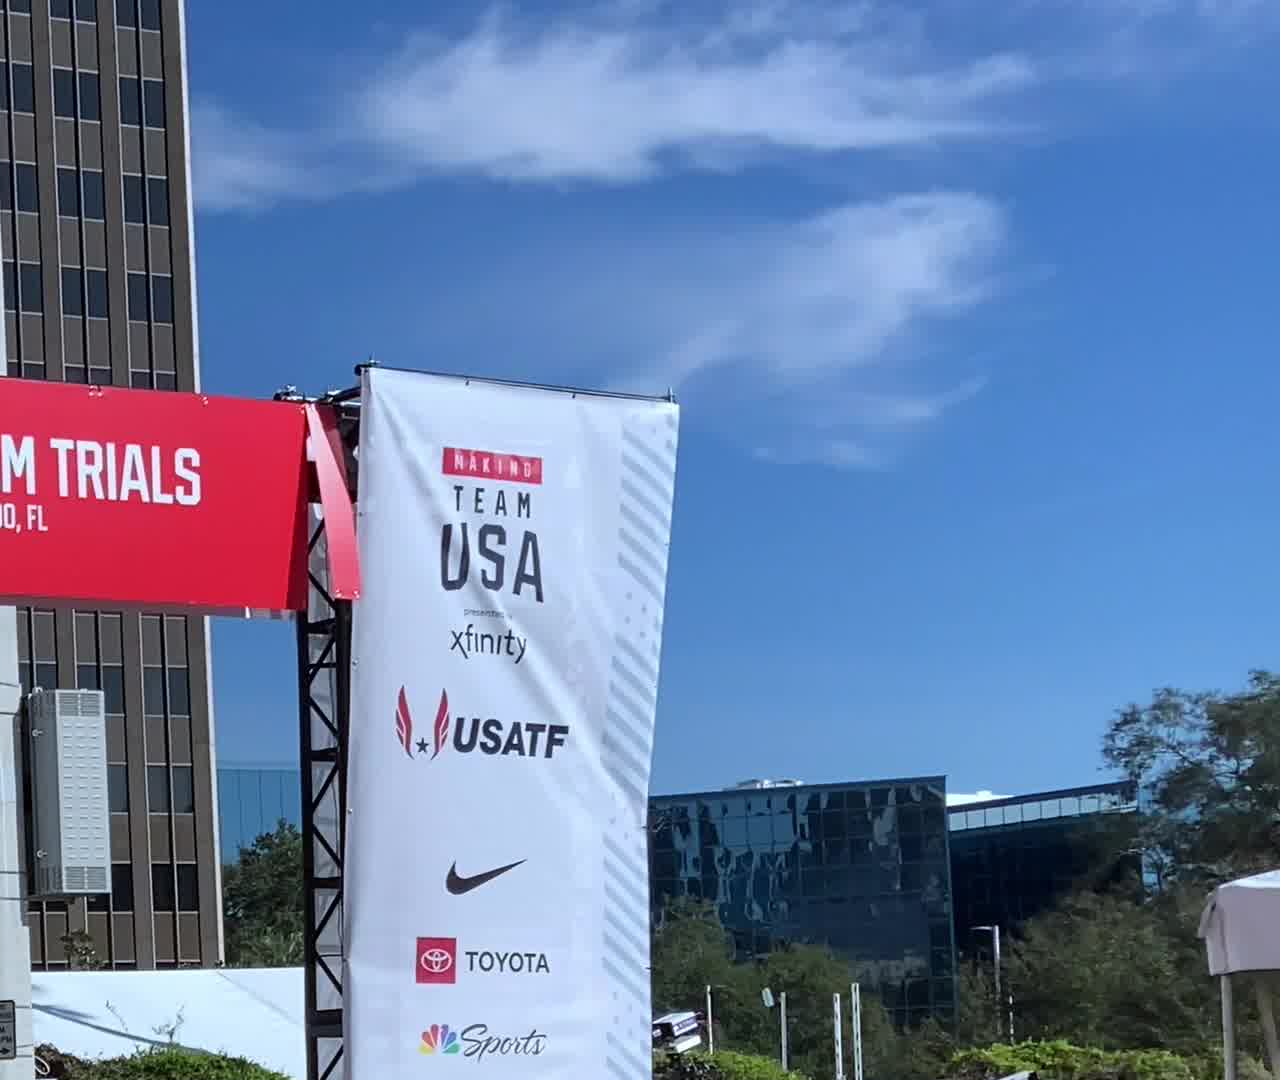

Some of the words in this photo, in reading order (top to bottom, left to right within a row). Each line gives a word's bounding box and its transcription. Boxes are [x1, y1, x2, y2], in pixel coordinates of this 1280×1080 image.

[49, 438, 202, 507] TRIALS
[26, 502, 49, 532] FL
[453, 485, 532, 519] TEAM
[440, 522, 544, 603] USA
[450, 623, 527, 664] xfinity
[452, 717, 569, 758] USATF
[465, 951, 550, 974] TOYOTA
[460, 1023, 548, 1063] Sports
